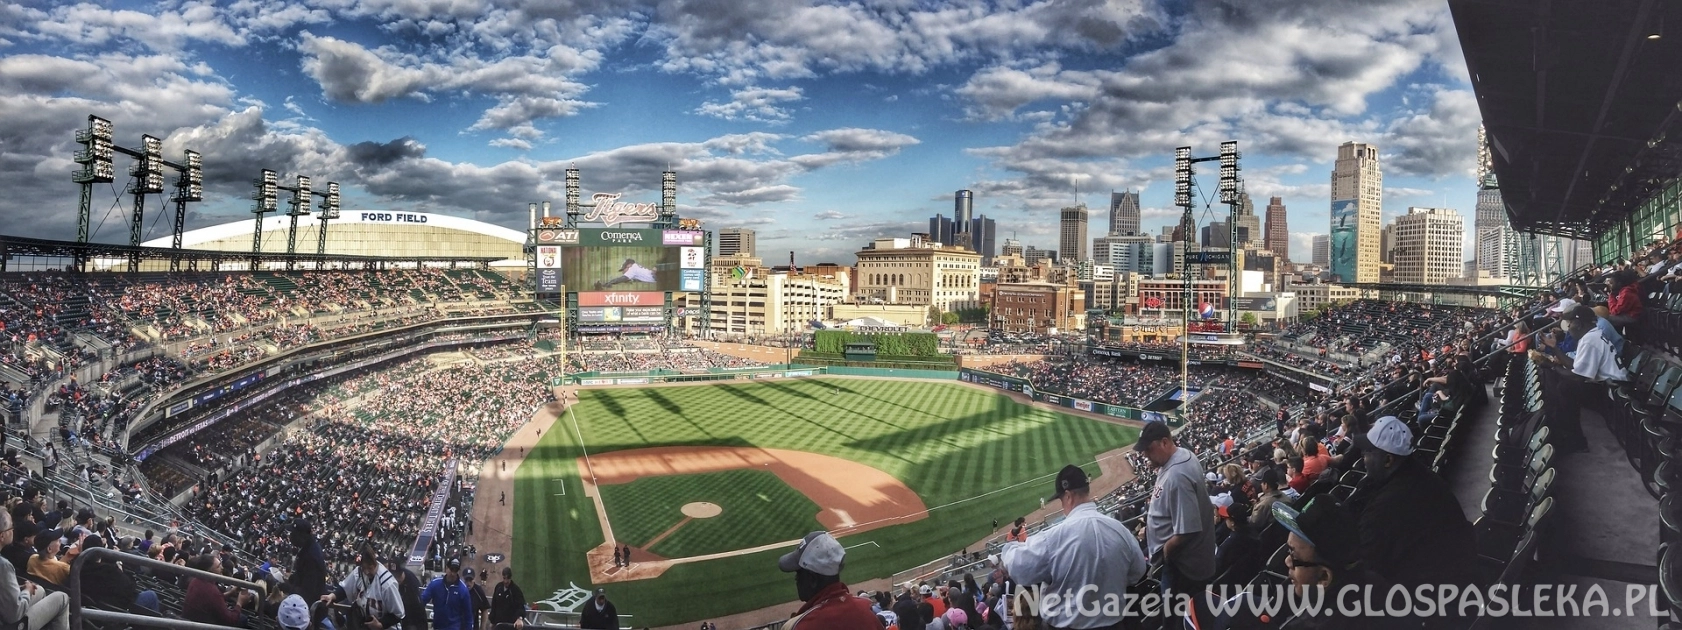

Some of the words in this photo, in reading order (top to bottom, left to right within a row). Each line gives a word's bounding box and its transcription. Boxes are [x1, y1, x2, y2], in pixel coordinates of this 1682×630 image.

[584, 192, 658, 227] Tigers
[361, 212, 392, 221] FORD
[396, 213, 428, 223] FIELD
[554, 231, 579, 239] ATI
[1200, 252, 1230, 261] MICHIGAN
[604, 292, 639, 304] xfinity
[1075, 401, 1090, 410] meijer
[169, 428, 189, 444] DETROIT
[195, 420, 209, 431] TEXAS
